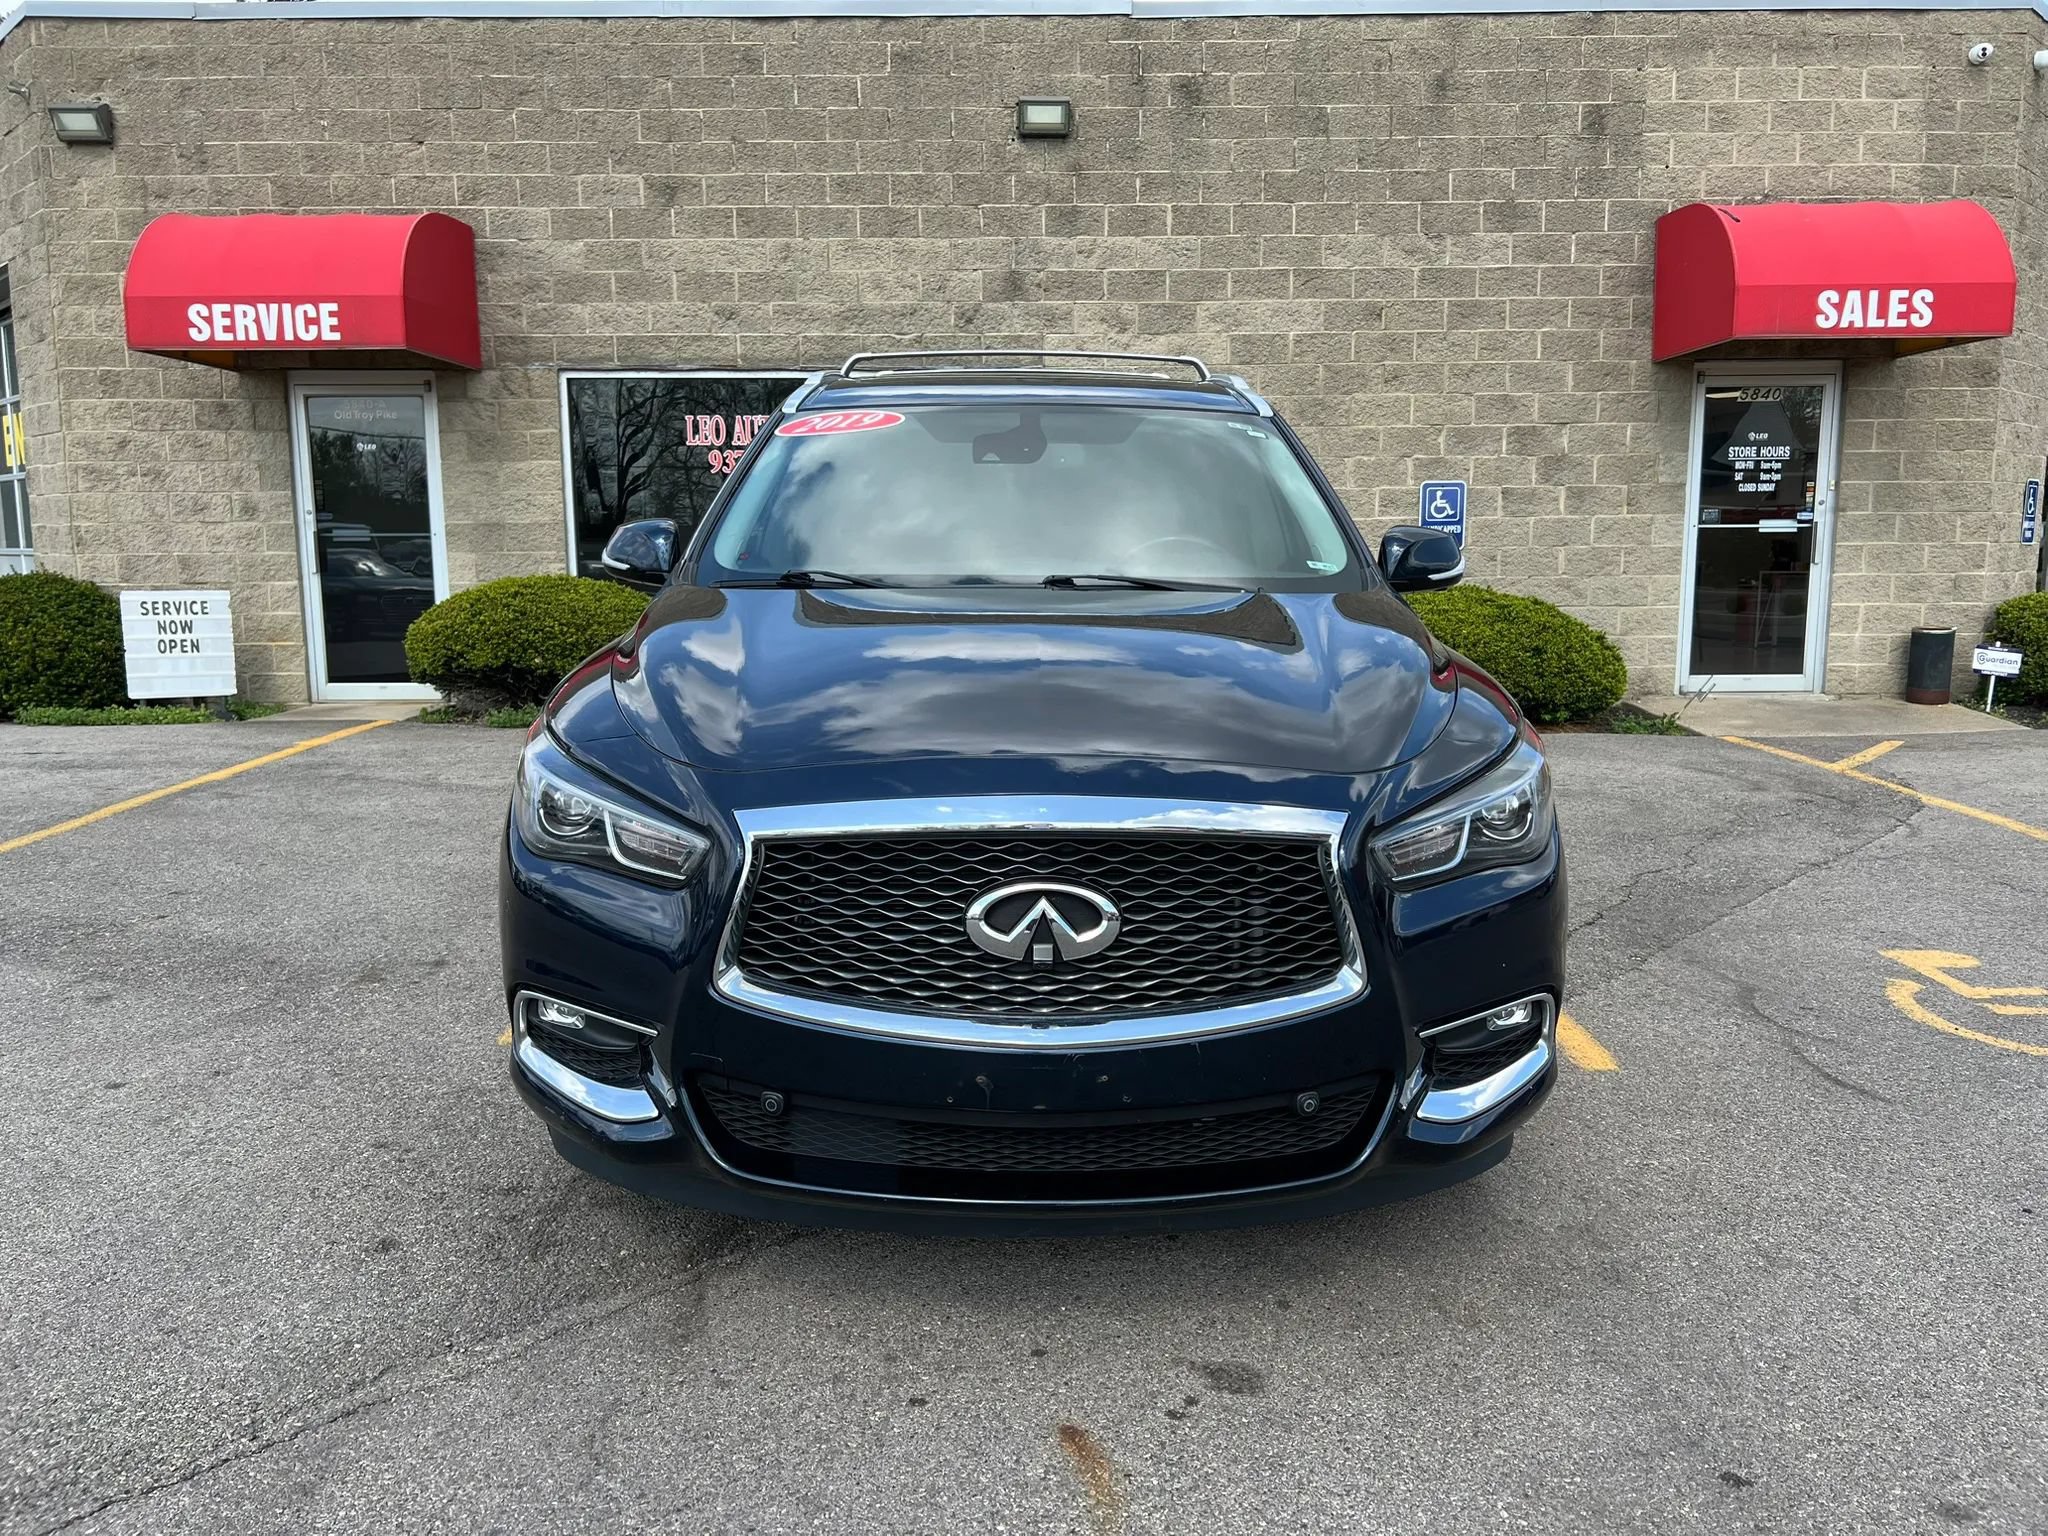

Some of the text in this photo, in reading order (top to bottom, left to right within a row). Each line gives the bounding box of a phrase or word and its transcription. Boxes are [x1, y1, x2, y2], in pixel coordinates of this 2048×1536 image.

[1815, 288, 1934, 329] SALES
[187, 302, 341, 342] SERVICE
[1740, 388, 1781, 400] 5840
[334, 409, 398, 421] Old Troy Pike
[794, 412, 883, 433] 2019
[684, 415, 726, 446] LEO
[1755, 432, 1769, 440] LEO
[1728, 446, 1790, 458] STORE HOURS
[1735, 461, 1754, 469] MON-FRI
[1734, 472, 1744, 480] SAT
[1738, 483, 1776, 491] CLOSED SUNDAY
[140, 600, 209, 616] SERVICE
[157, 619, 193, 635] NOW
[157, 638, 200, 654] OPEN
[1979, 654, 2019, 666] Guardian
